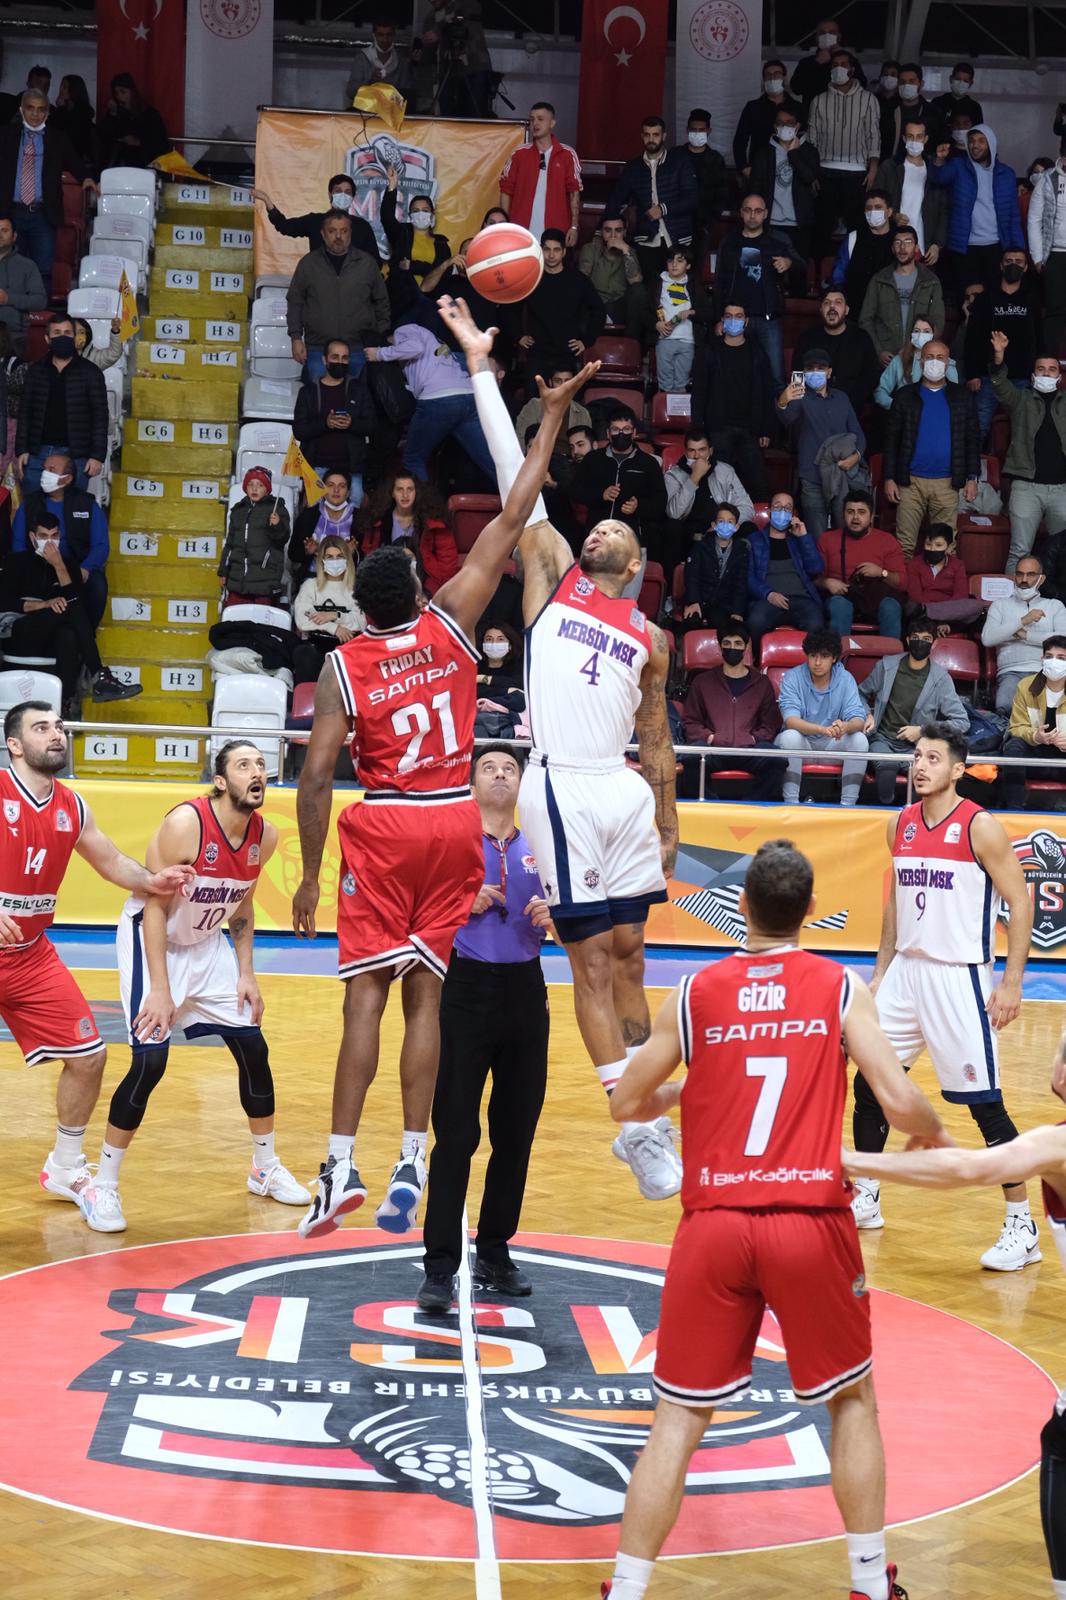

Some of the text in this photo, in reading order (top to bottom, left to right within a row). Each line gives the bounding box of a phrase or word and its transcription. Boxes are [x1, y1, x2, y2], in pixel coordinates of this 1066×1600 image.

[181, 188, 207, 200] G 11
[233, 192, 243, 202] H
[175, 230, 203, 241] G 10
[223, 233, 251, 244] H 10
[172, 273, 193, 284] G 9
[215, 277, 240, 288] H 9
[161, 324, 183, 334] G 8
[212, 325, 234, 336] H 8
[157, 348, 178, 359] G 7
[208, 352, 232, 362] H 7
[145, 425, 168, 436] G 6
[199, 428, 222, 439] H 6
[134, 479, 157, 492] G 5
[127, 538, 151, 550] G 4
[185, 541, 209, 553] H 4
[136, 603, 144, 615] 3
[175, 605, 201, 618] H 3
[557, 618, 638, 668] MERSİN MSK
[378, 645, 434, 680] FRIDAY
[579, 651, 601, 686] 4
[124, 671, 132, 683] 2
[169, 672, 196, 686] H 2
[367, 660, 459, 706] SAMPA
[391, 690, 460, 773] 21
[93, 742, 118, 755] G 1
[164, 744, 190, 757] H 1
[24, 846, 48, 875] 14
[929, 869, 954, 890] MSK
[915, 891, 926, 921] 9
[192, 907, 227, 931] 10
[738, 981, 786, 1013] GİZİR
[705, 1019, 829, 1045] SAMPA
[743, 1056, 788, 1157] 7
[748, 1167, 834, 1184] Kağıtçılık
[109, 1369, 351, 1394] BELEDİYESİ
